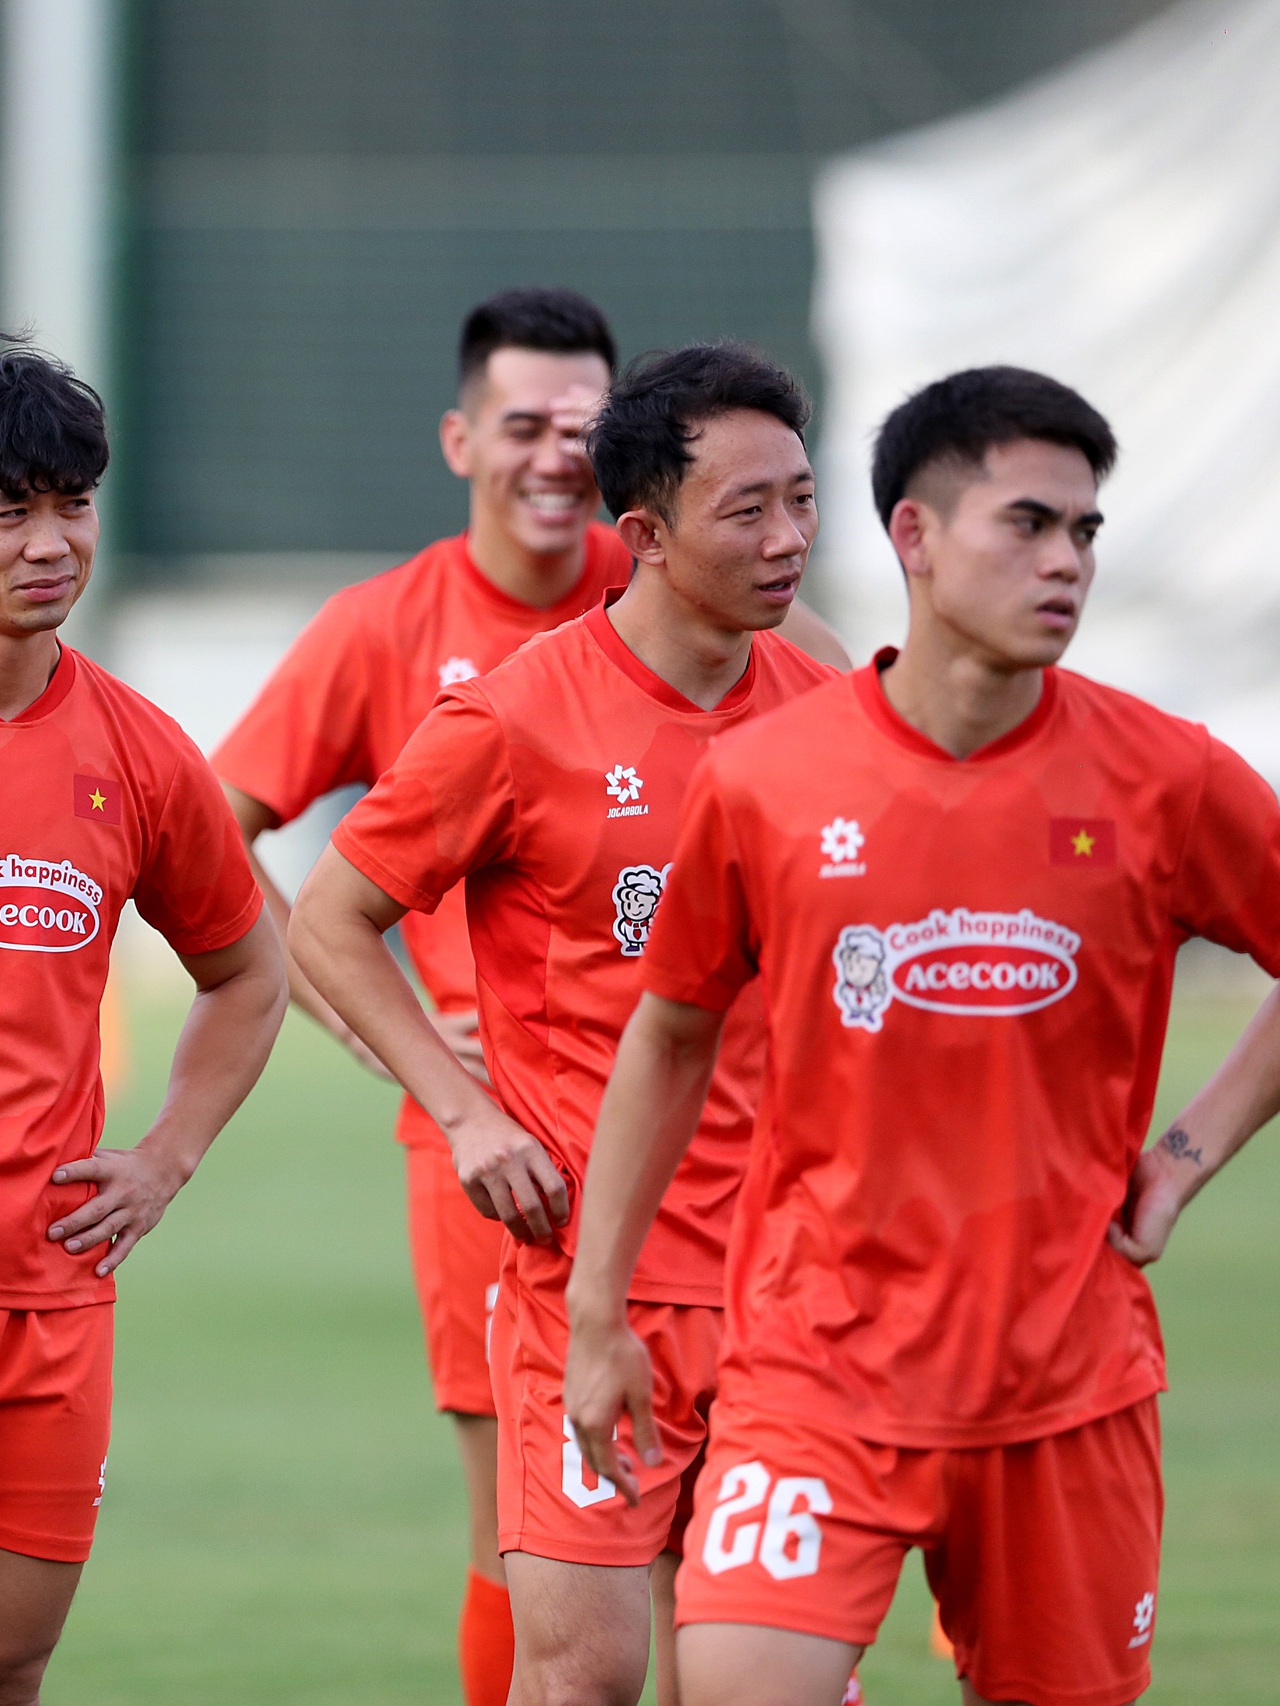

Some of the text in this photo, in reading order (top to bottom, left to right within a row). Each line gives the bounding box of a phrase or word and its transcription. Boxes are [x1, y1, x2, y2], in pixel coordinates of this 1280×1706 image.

[607, 805, 649, 818] JOGARBOLA
[11, 859, 101, 904] happiness
[890, 915, 1075, 952] Cook happiness
[703, 1460, 833, 1580] 26
